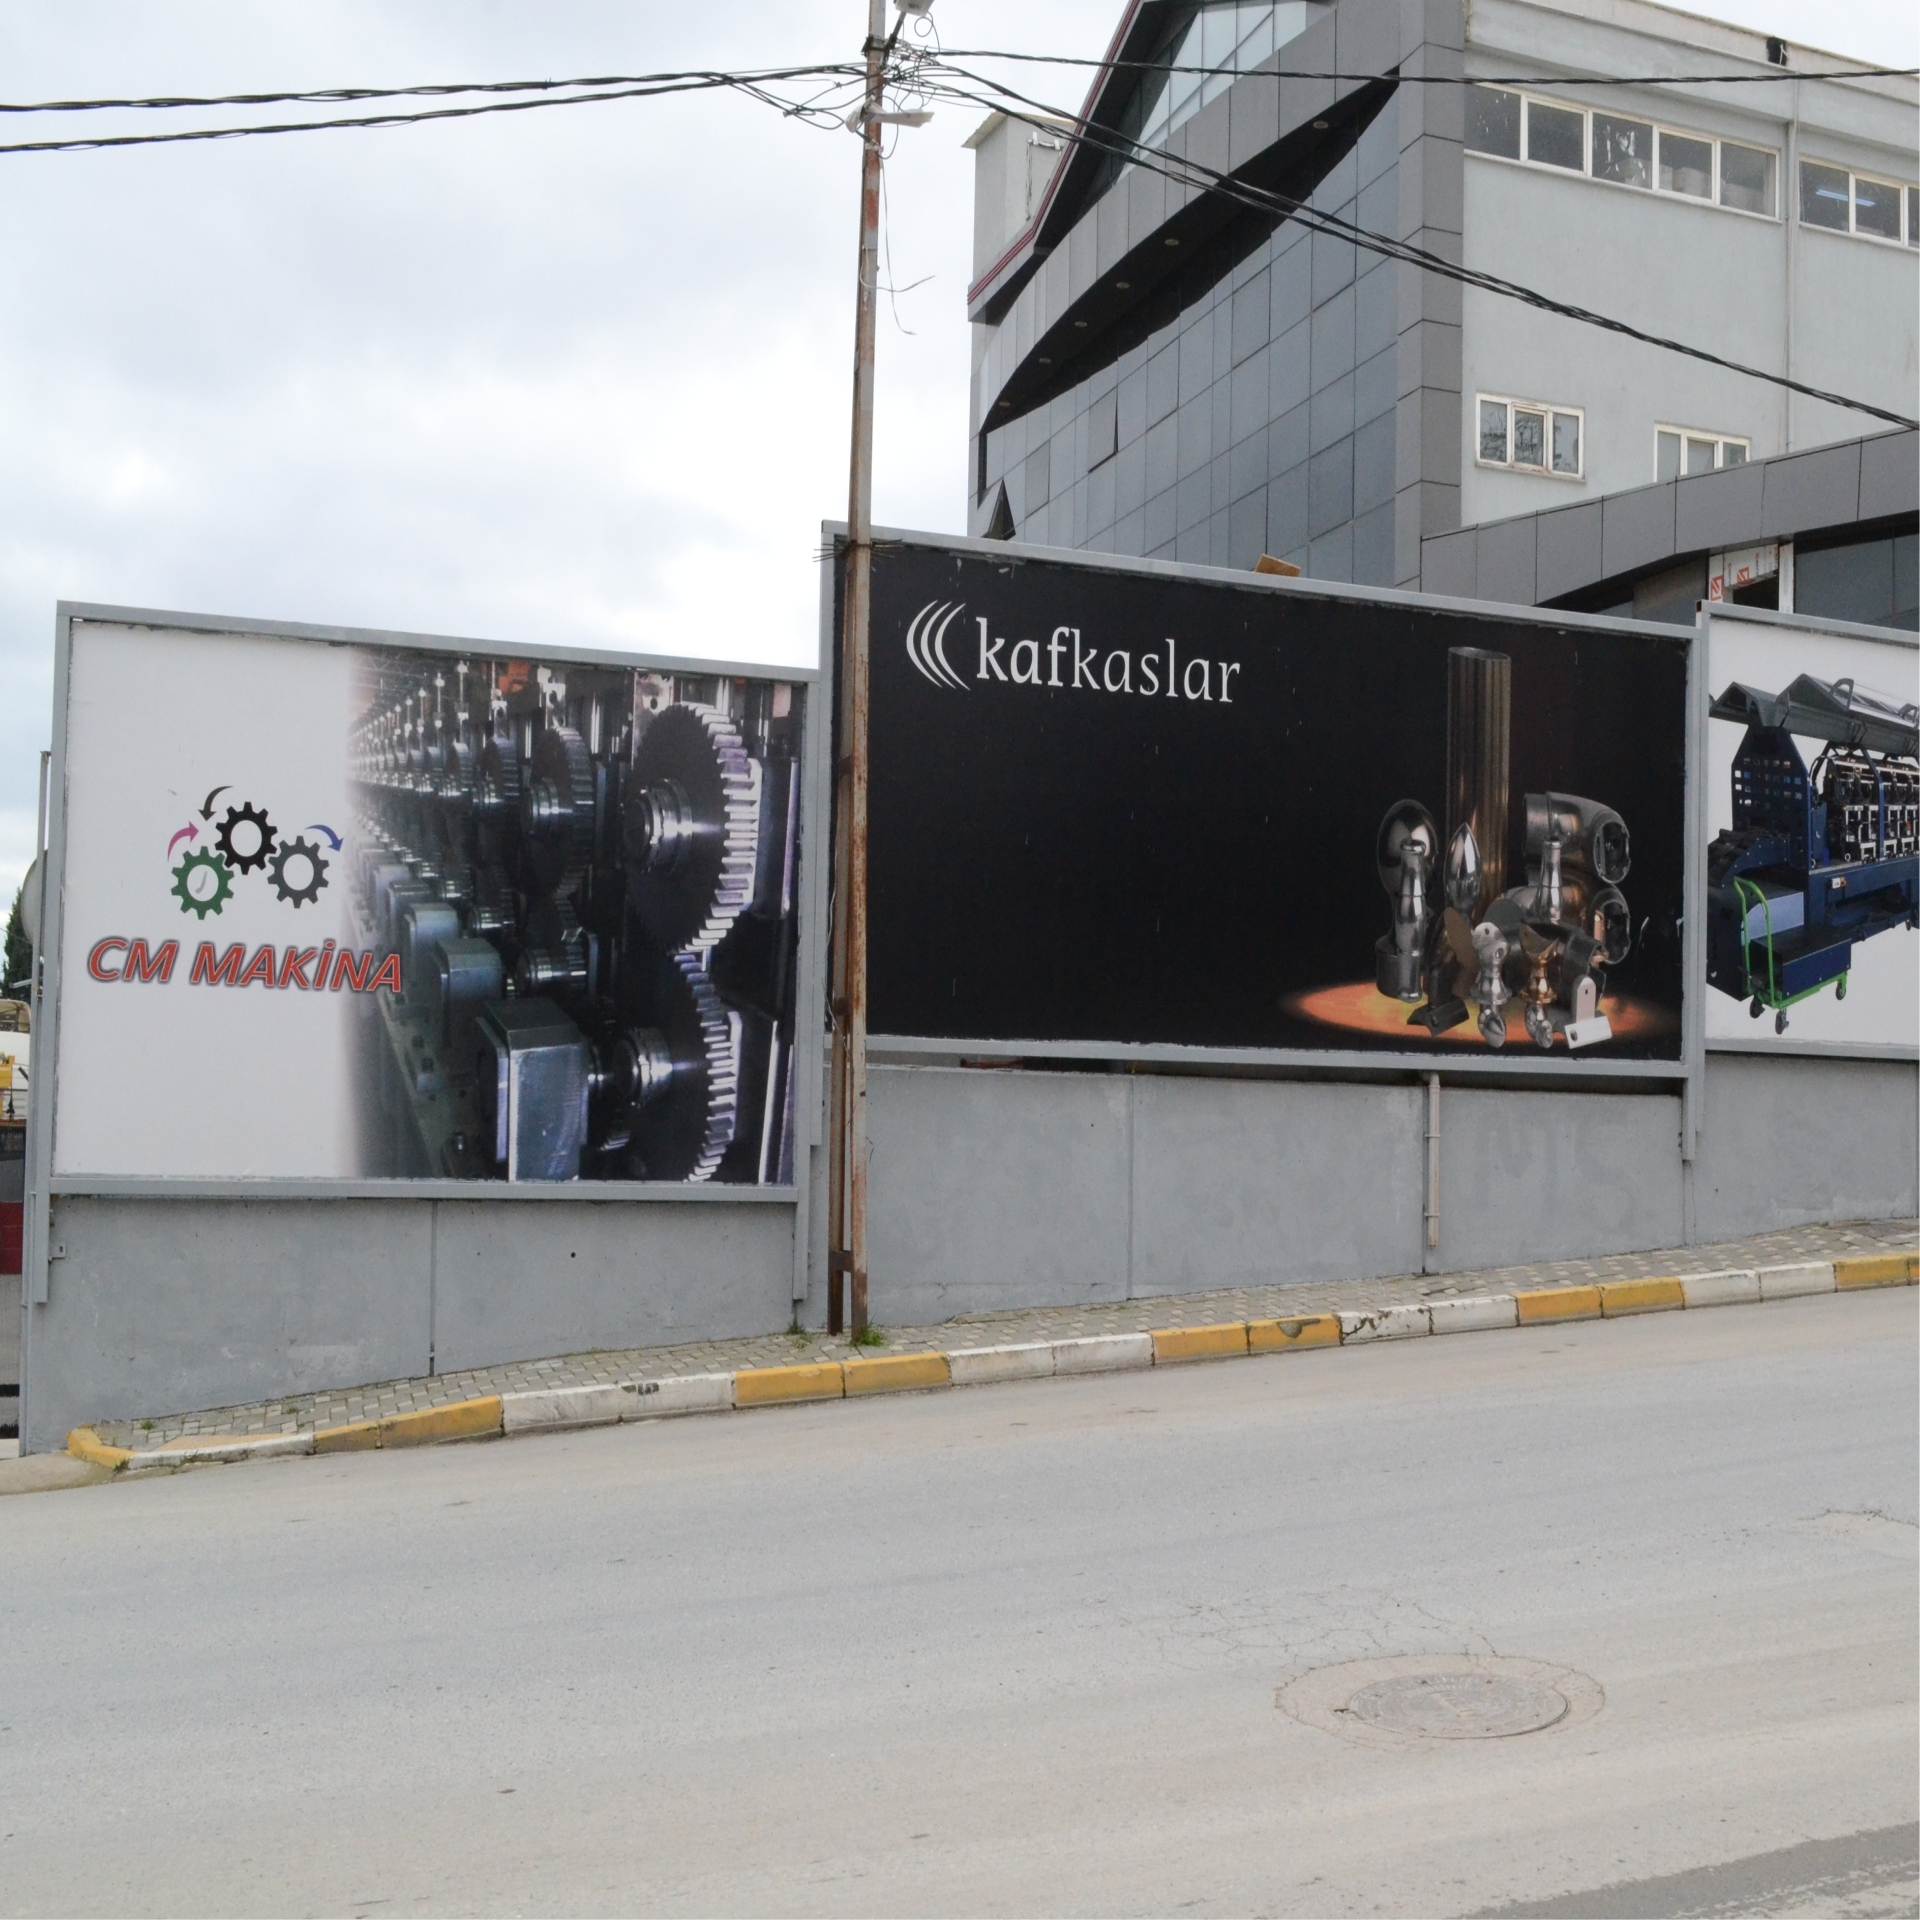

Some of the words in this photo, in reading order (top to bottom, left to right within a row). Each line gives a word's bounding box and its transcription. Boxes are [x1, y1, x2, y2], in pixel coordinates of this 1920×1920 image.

[975, 616, 1241, 703] kafkaslar
[89, 938, 178, 982] CM
[190, 939, 401, 993] MAKİNA
